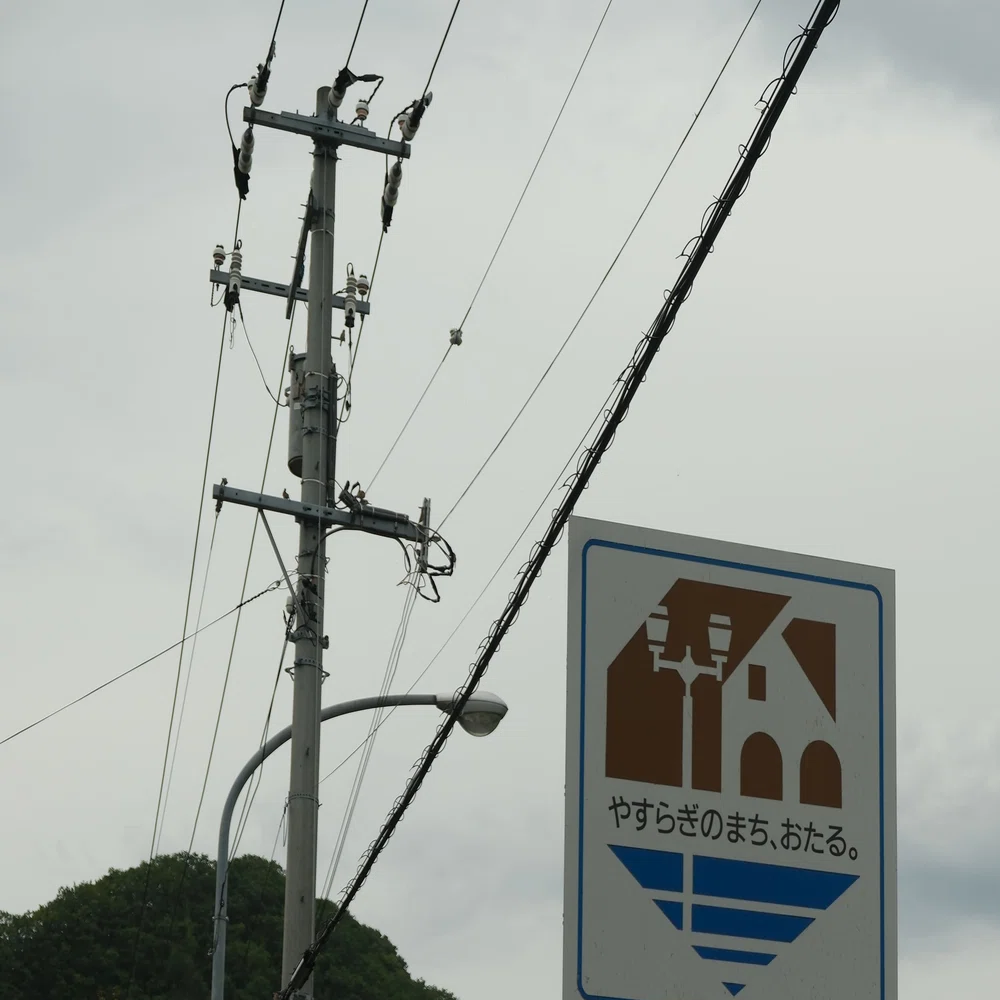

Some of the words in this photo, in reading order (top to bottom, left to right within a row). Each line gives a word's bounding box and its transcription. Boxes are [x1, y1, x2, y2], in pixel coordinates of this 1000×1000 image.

[608, 794, 858, 861] やすらぎのまち、おたる。
